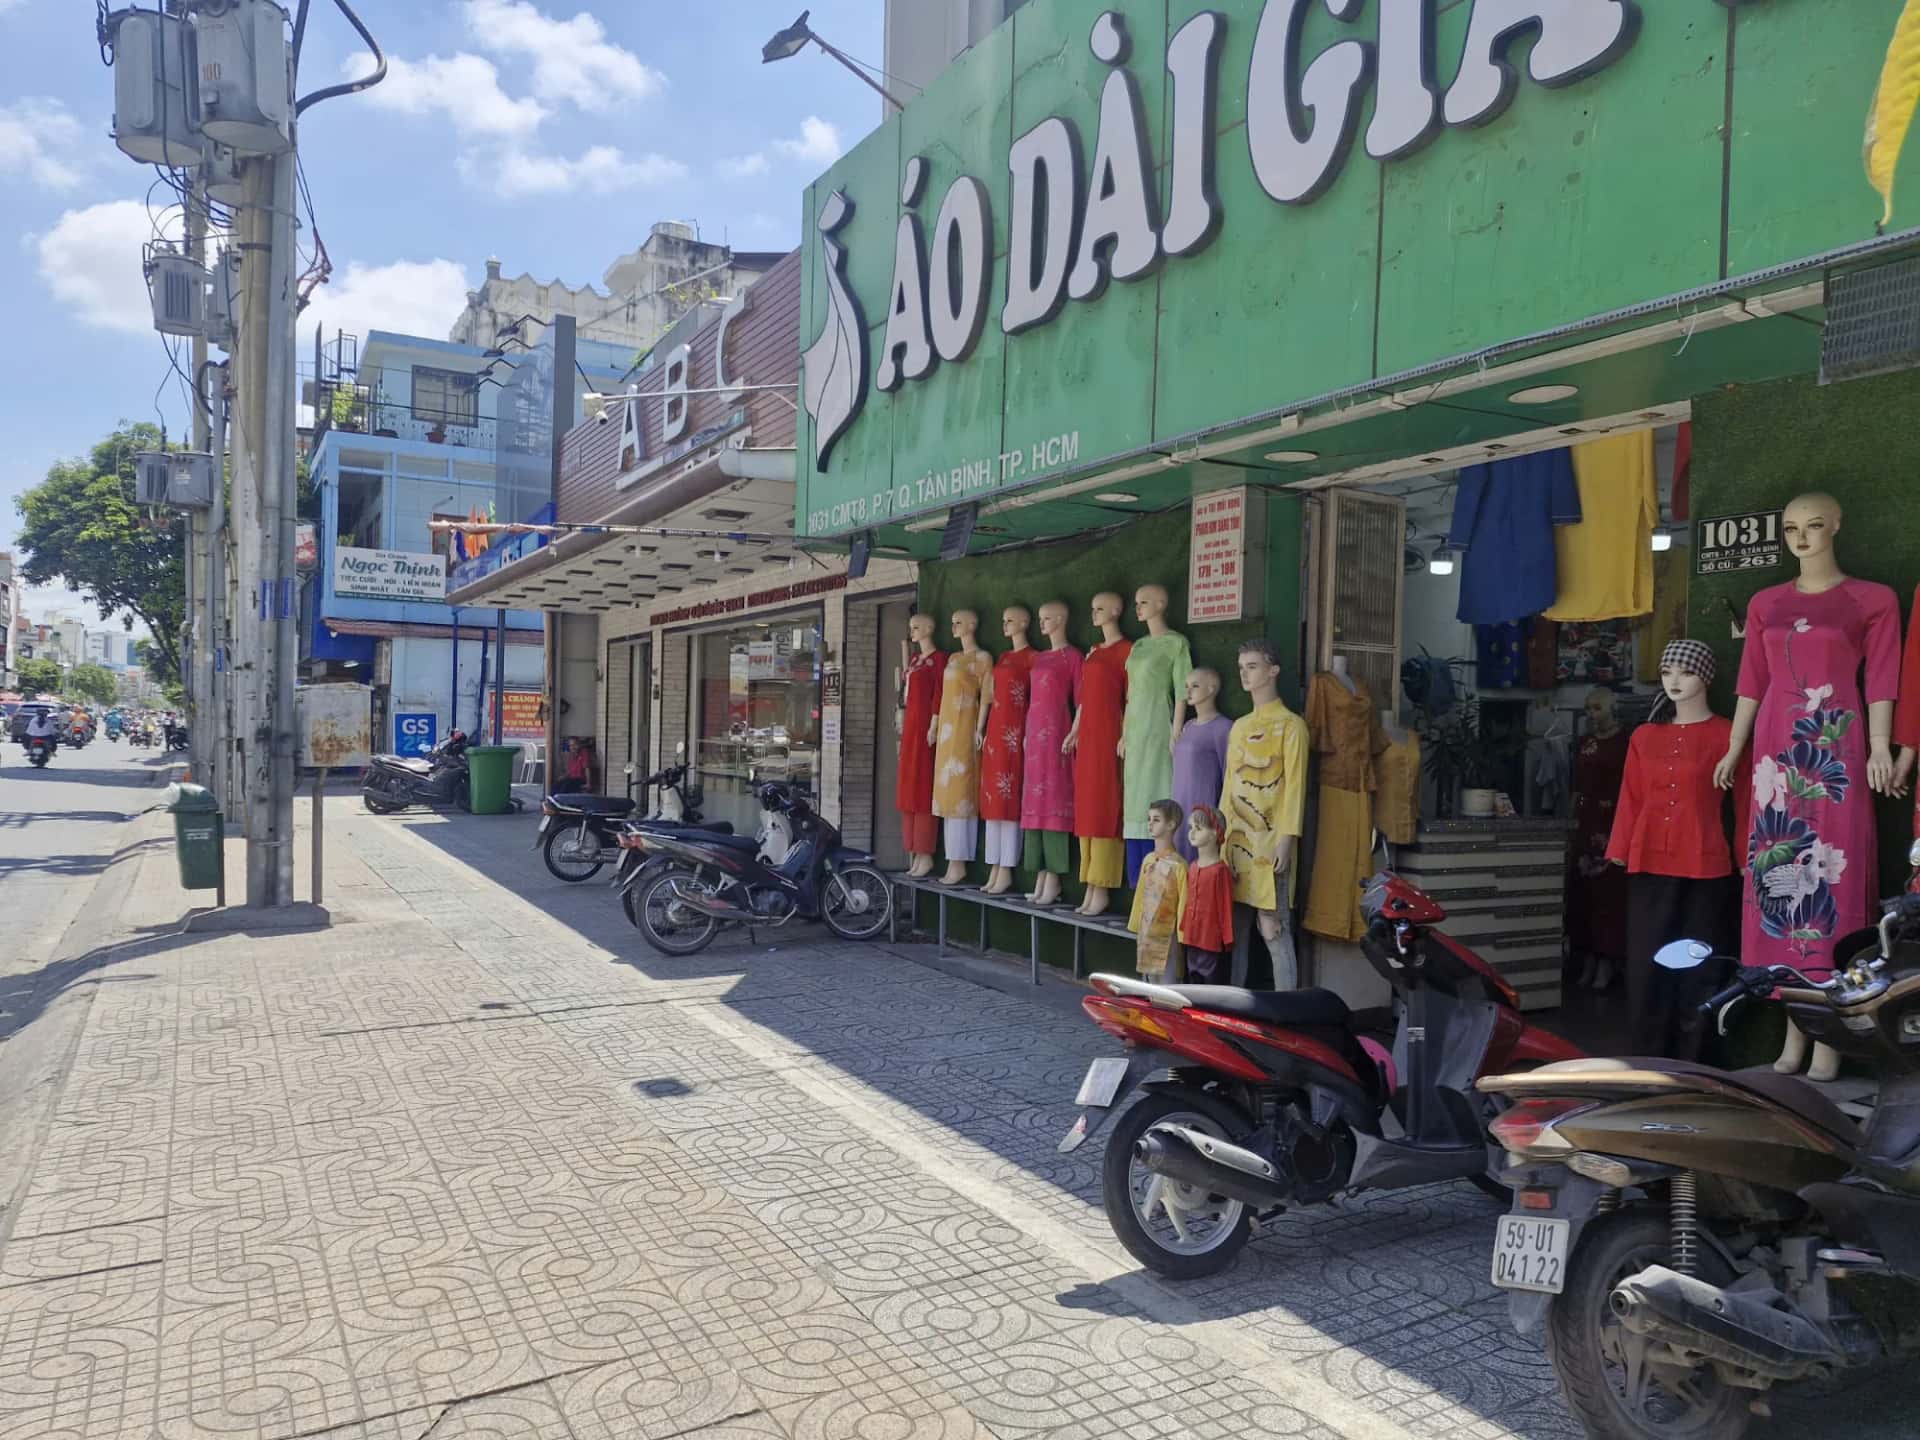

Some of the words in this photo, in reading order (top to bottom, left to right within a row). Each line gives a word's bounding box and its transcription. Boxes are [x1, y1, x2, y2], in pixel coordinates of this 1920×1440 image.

[877, 156, 993, 393] ÁO
[1001, 10, 1227, 336] DÀI
[1032, 431, 1080, 472] HCM
[1702, 514, 1777, 549] 1031
[340, 556, 389, 574] Ngọc
[393, 560, 442, 578] Thịnh
[1739, 554, 1778, 567] 263
[402, 718, 429, 735] GS
[1506, 1222, 1554, 1253] 59-U1
[1497, 1252, 1559, 1286] 041.22
